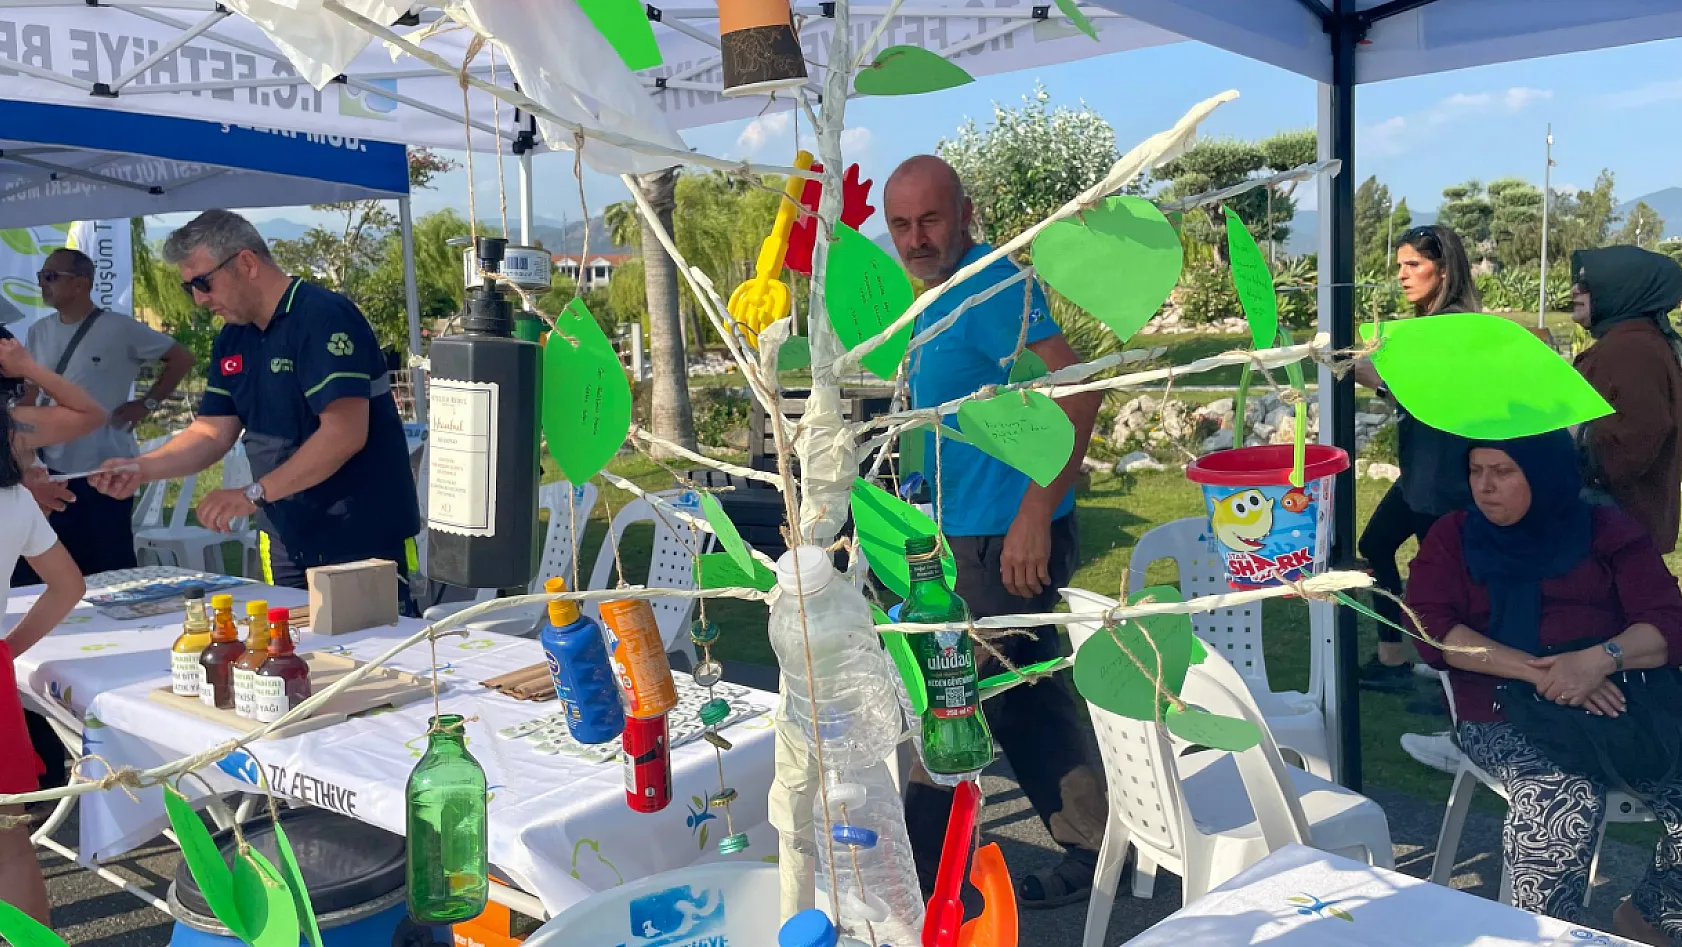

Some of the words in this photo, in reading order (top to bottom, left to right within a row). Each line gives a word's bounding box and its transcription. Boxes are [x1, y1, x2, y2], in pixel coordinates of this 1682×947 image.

[1229, 547, 1313, 578] SHARK
[927, 649, 972, 671] uludağ
[259, 703, 279, 713] YAĞI
